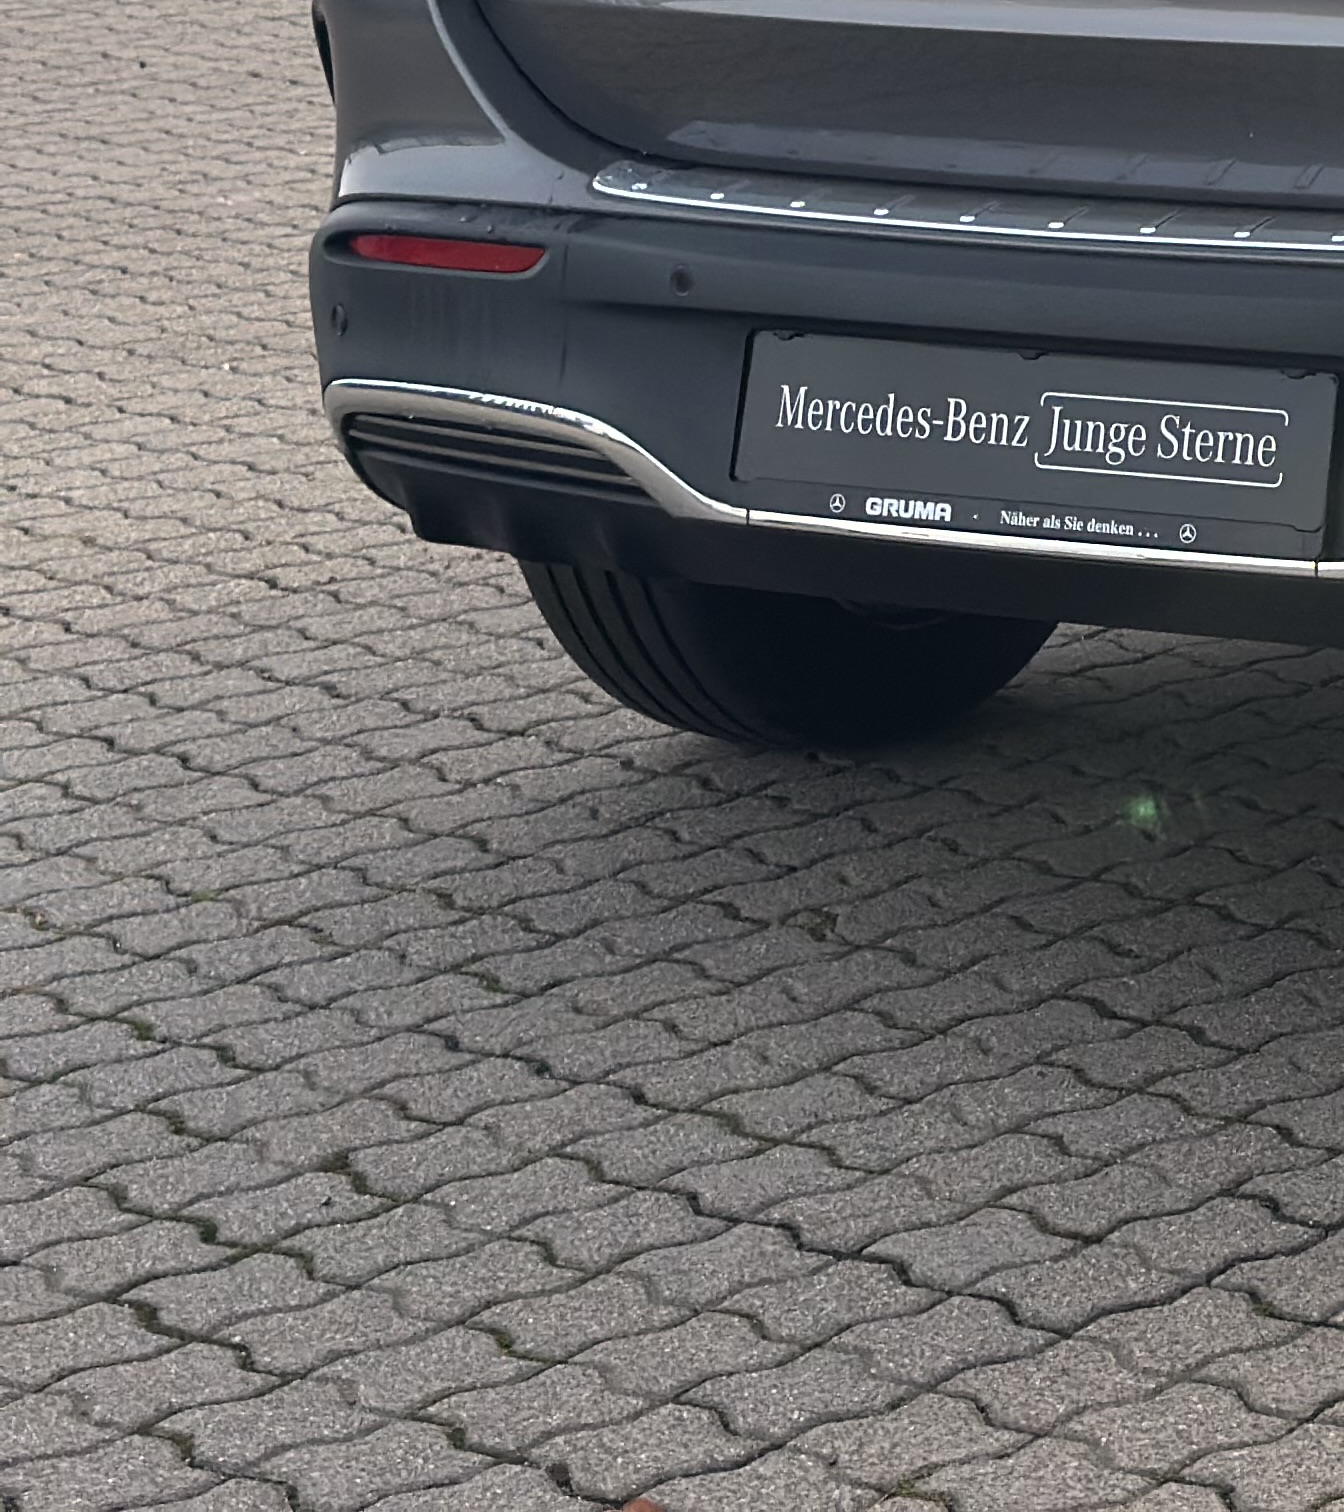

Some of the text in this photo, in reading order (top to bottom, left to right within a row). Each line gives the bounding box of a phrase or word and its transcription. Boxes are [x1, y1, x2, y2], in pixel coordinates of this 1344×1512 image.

[775, 384, 1278, 469] Mercedes-Benz Junge Sterne
[865, 496, 952, 522] GRUMA
[999, 509, 1040, 529] Näher
[1042, 515, 1061, 530] als
[1064, 515, 1084, 531] Sie
[1086, 518, 1134, 537] denken
